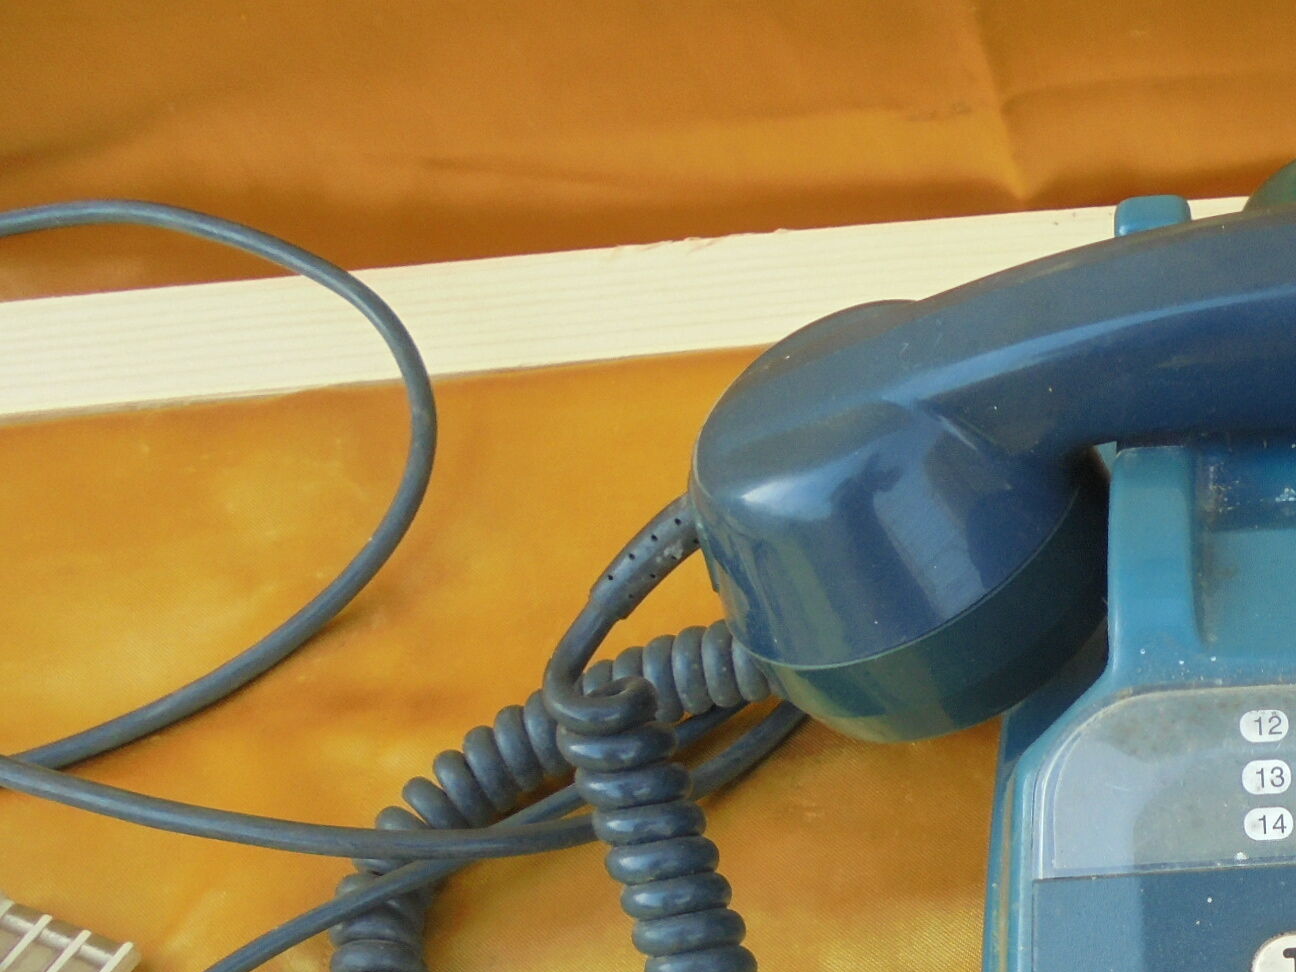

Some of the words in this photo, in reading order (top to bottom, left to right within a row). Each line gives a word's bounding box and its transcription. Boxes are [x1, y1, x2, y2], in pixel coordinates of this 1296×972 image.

[1253, 715, 1283, 736] 12
[1255, 766, 1286, 789] 13
[1258, 814, 1287, 836] 14
